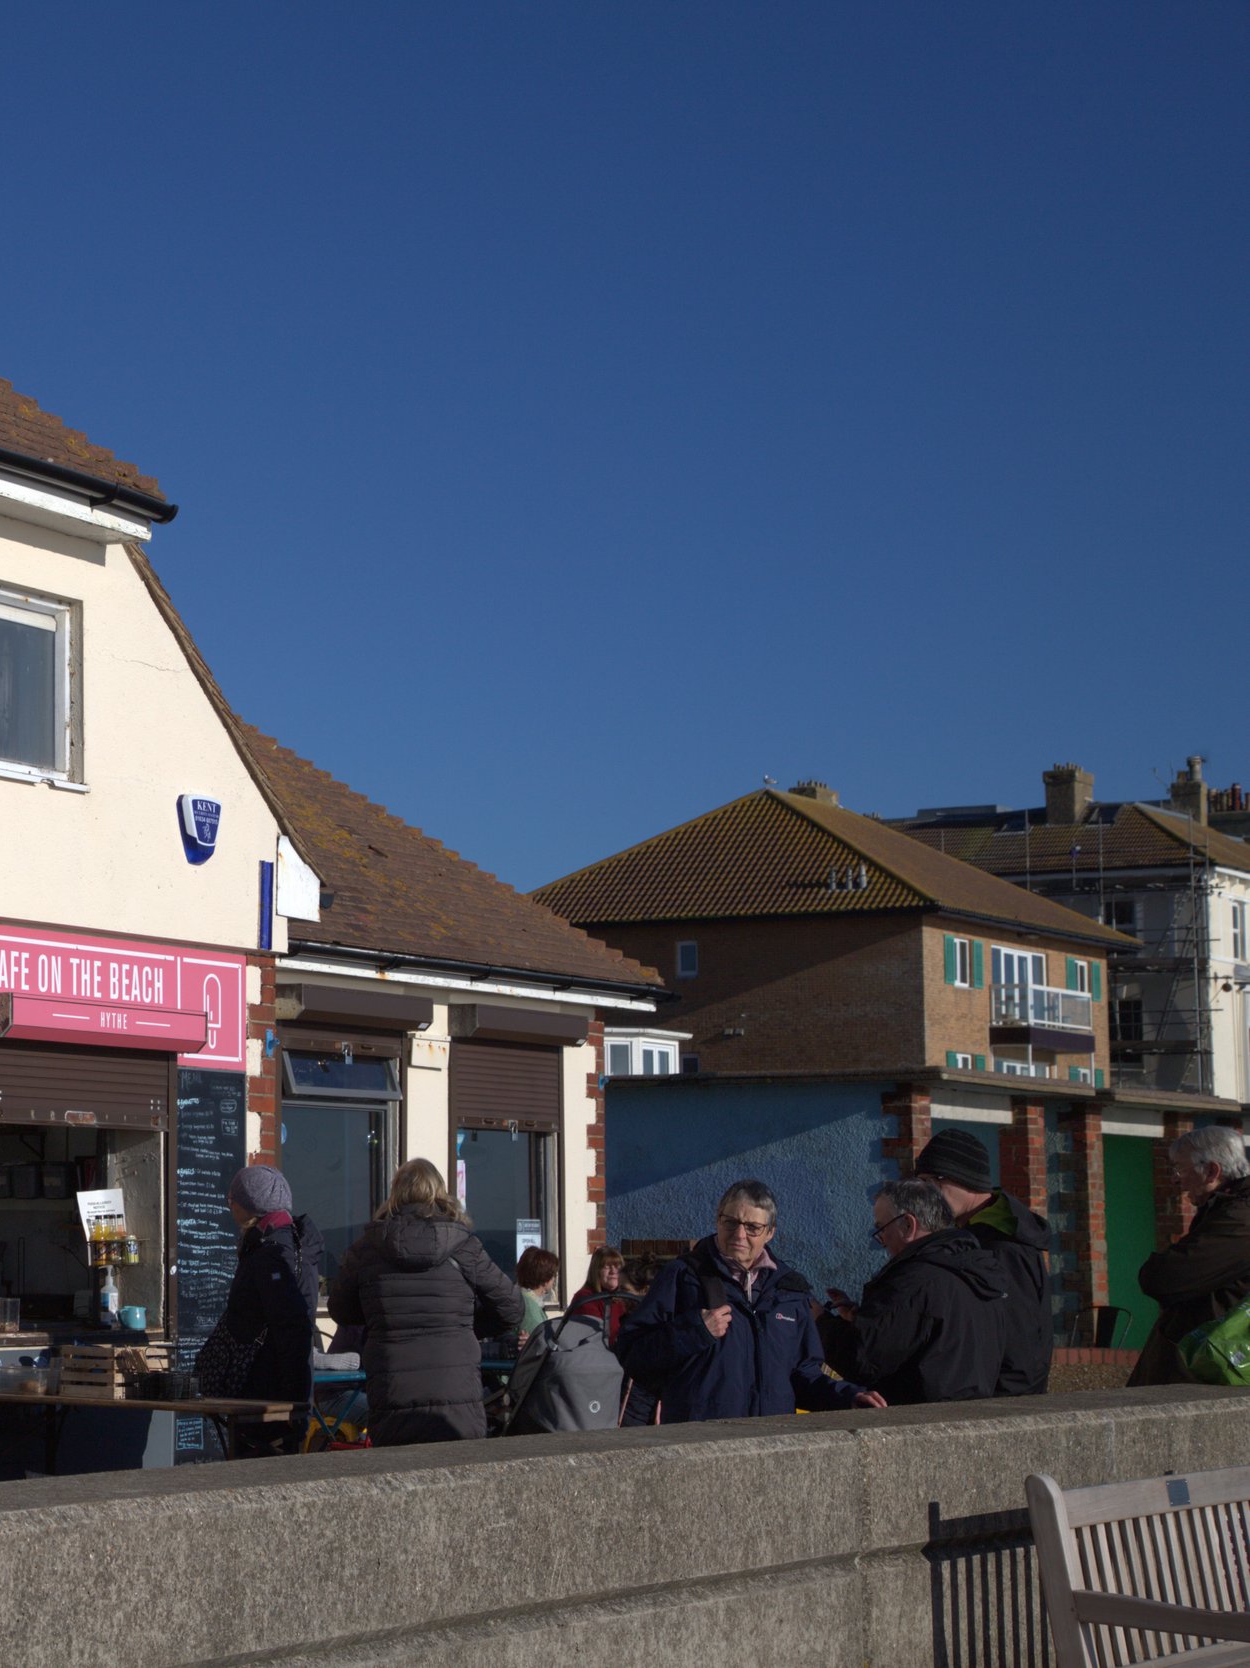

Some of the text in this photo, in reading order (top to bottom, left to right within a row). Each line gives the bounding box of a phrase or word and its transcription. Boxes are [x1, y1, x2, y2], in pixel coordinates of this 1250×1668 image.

[197, 800, 216, 813] KENT
[37, 954, 62, 994] ON
[70, 957, 103, 998] THE
[109, 962, 164, 1005] BEACH
[100, 1012, 128, 1030] HYTHE
